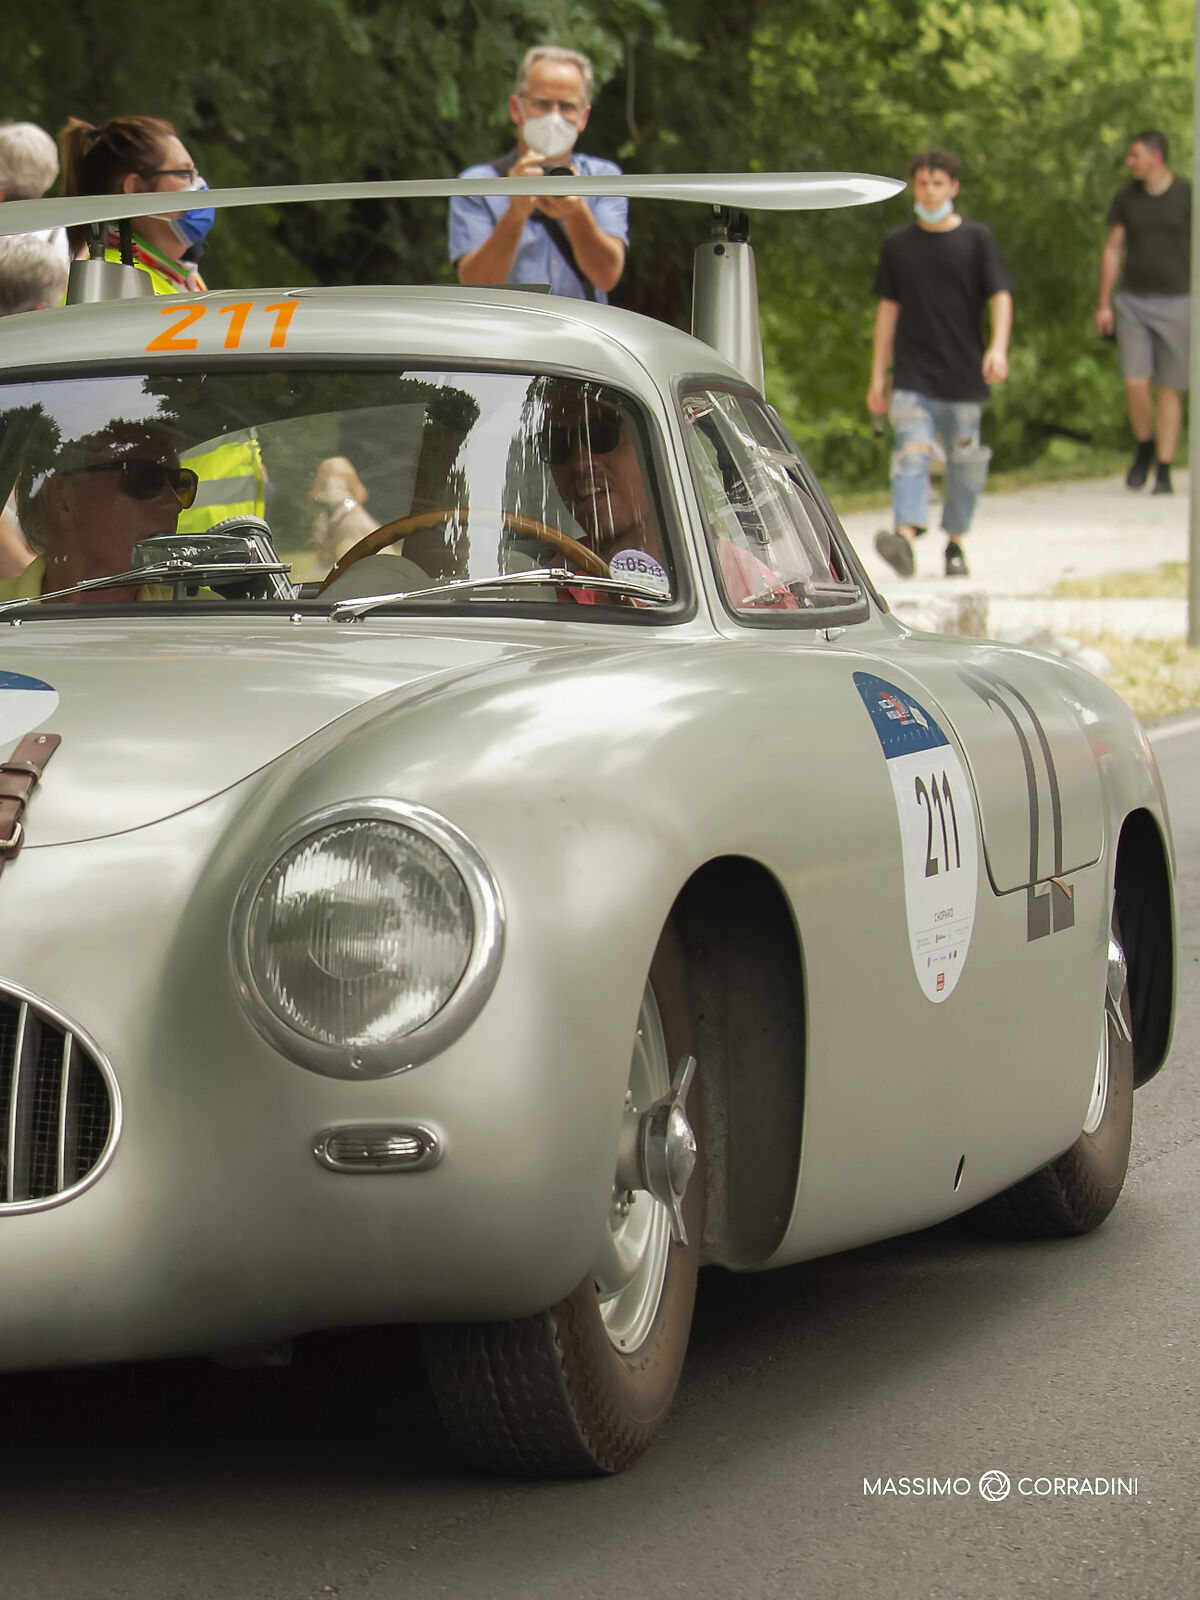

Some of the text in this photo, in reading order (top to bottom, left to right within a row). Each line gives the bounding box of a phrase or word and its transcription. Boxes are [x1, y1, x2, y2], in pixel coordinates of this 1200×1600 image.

[145, 300, 301, 352] 211
[626, 557, 647, 573] 05
[914, 770, 961, 878] 211
